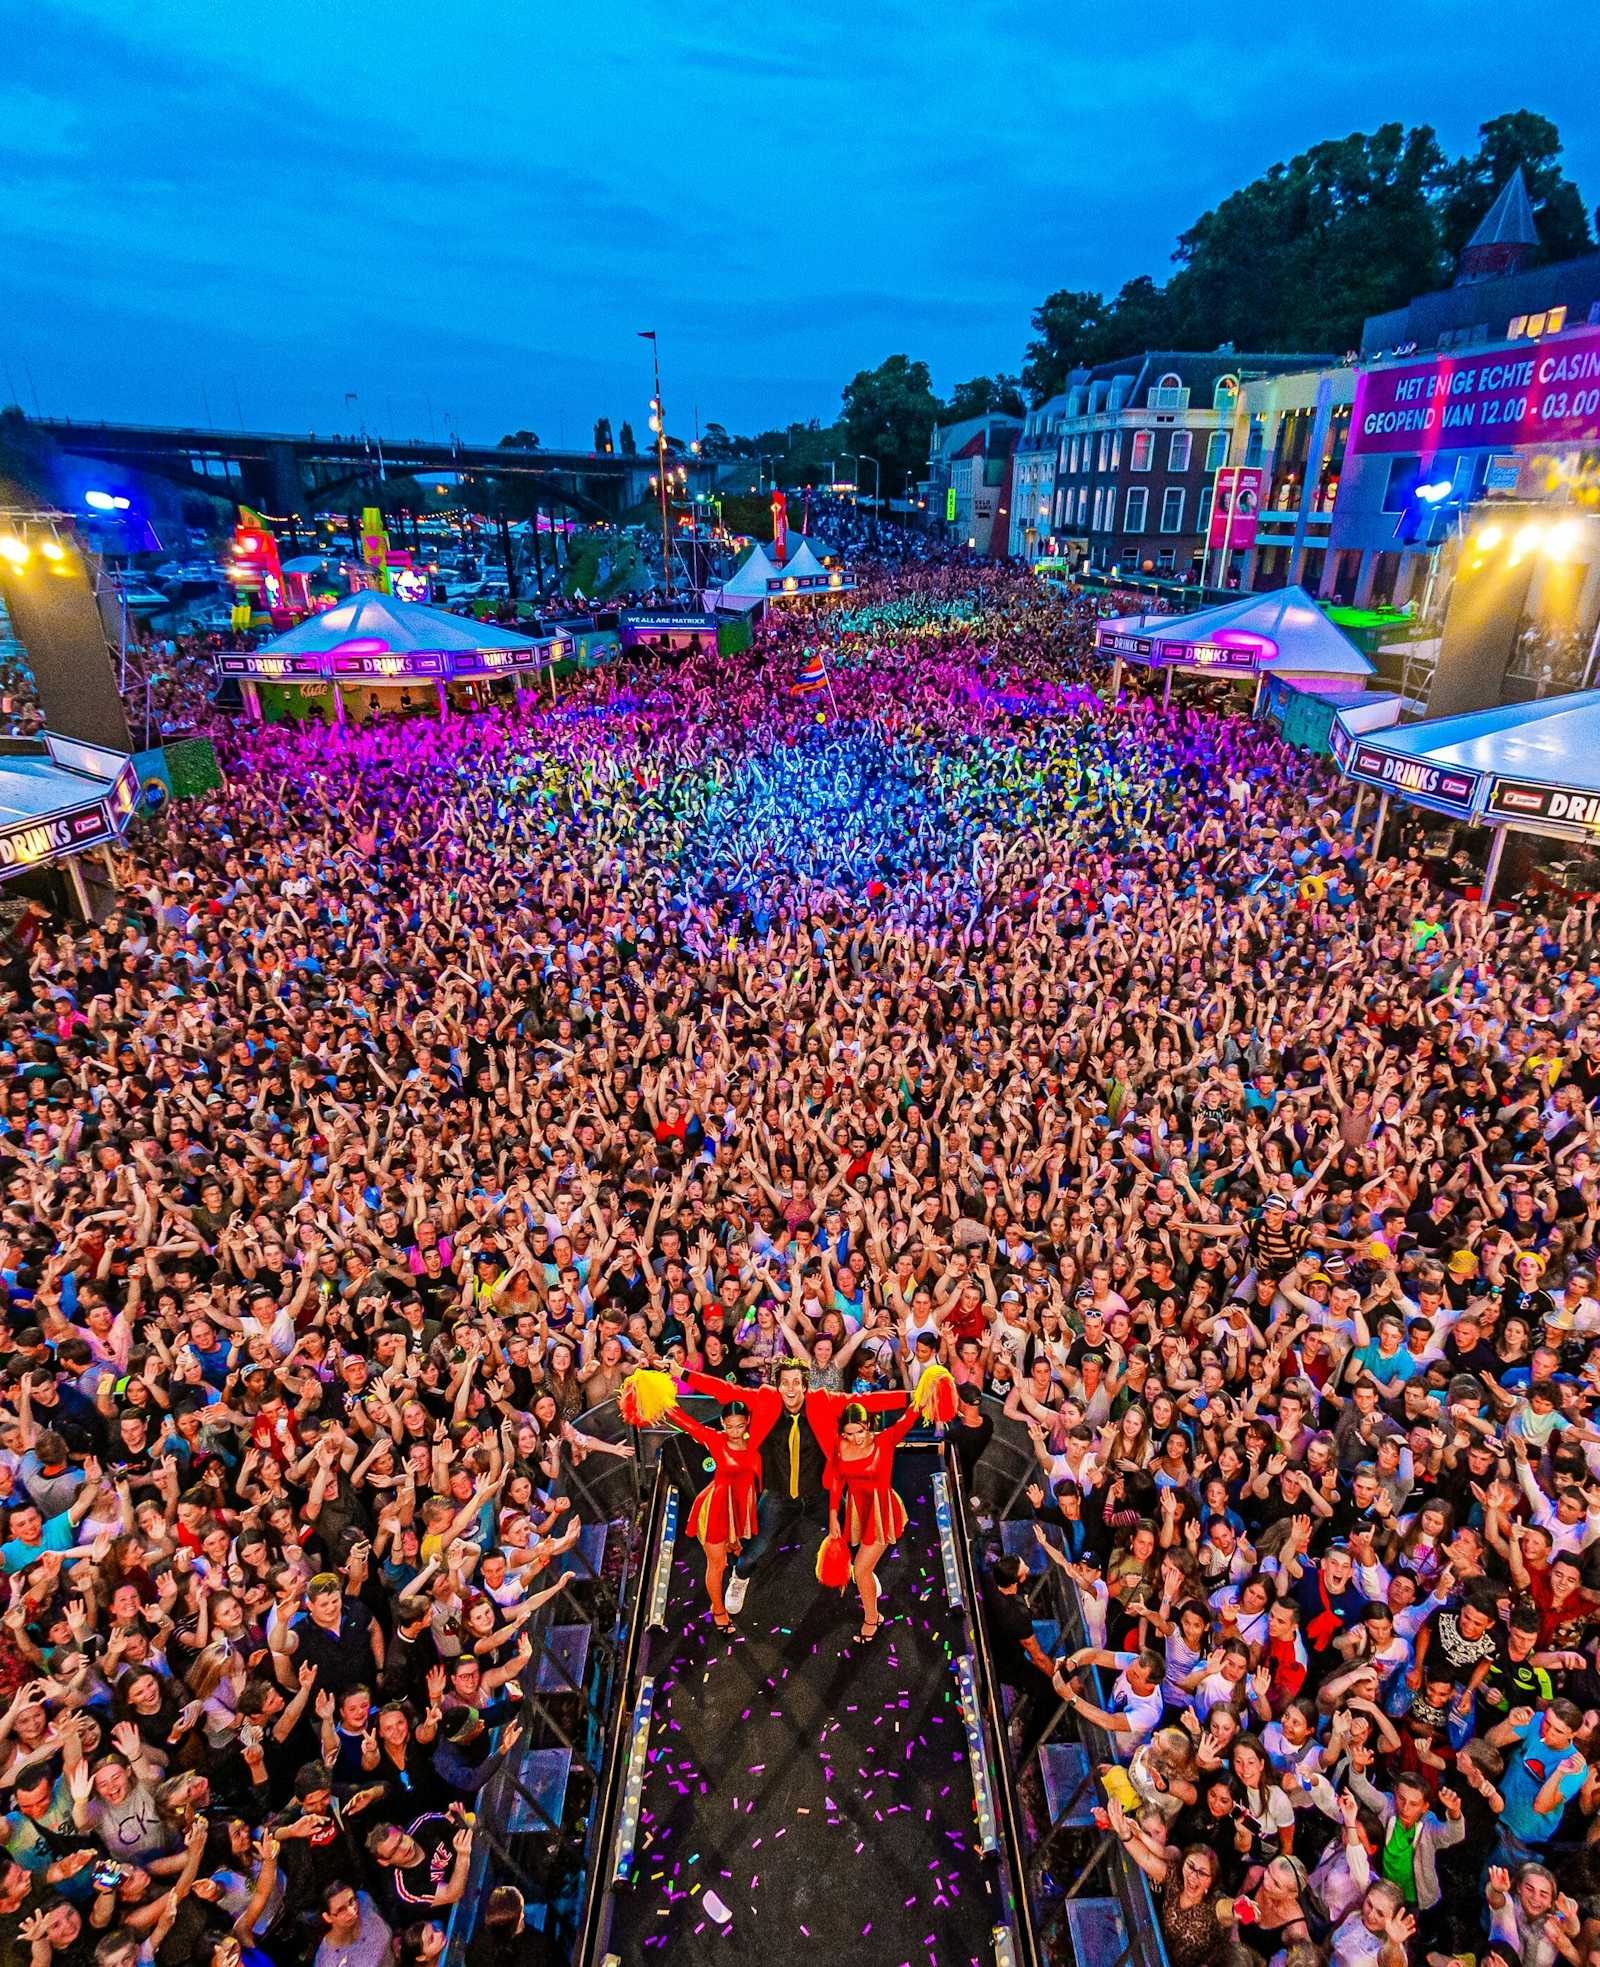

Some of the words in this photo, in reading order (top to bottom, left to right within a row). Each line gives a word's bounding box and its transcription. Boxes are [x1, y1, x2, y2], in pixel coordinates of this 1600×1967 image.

[1394, 377, 1424, 401] HET
[1426, 370, 1475, 397] ENIGE
[1478, 361, 1535, 392] ECHTE
[1364, 408, 1435, 434] GEOPEND
[1442, 403, 1475, 428] VAN
[1480, 397, 1527, 424] 12.00
[1542, 389, 1599, 419] 03.00
[1114, 637, 1138, 651] DRINKS
[478, 652, 513, 667] DRINKS
[1185, 647, 1228, 662] DRINKS
[246, 658, 293, 673] DRINKS
[363, 658, 413, 671] DRINKS
[1382, 758, 1440, 791] DRINKS
[1, 820, 72, 864] DRINKS
